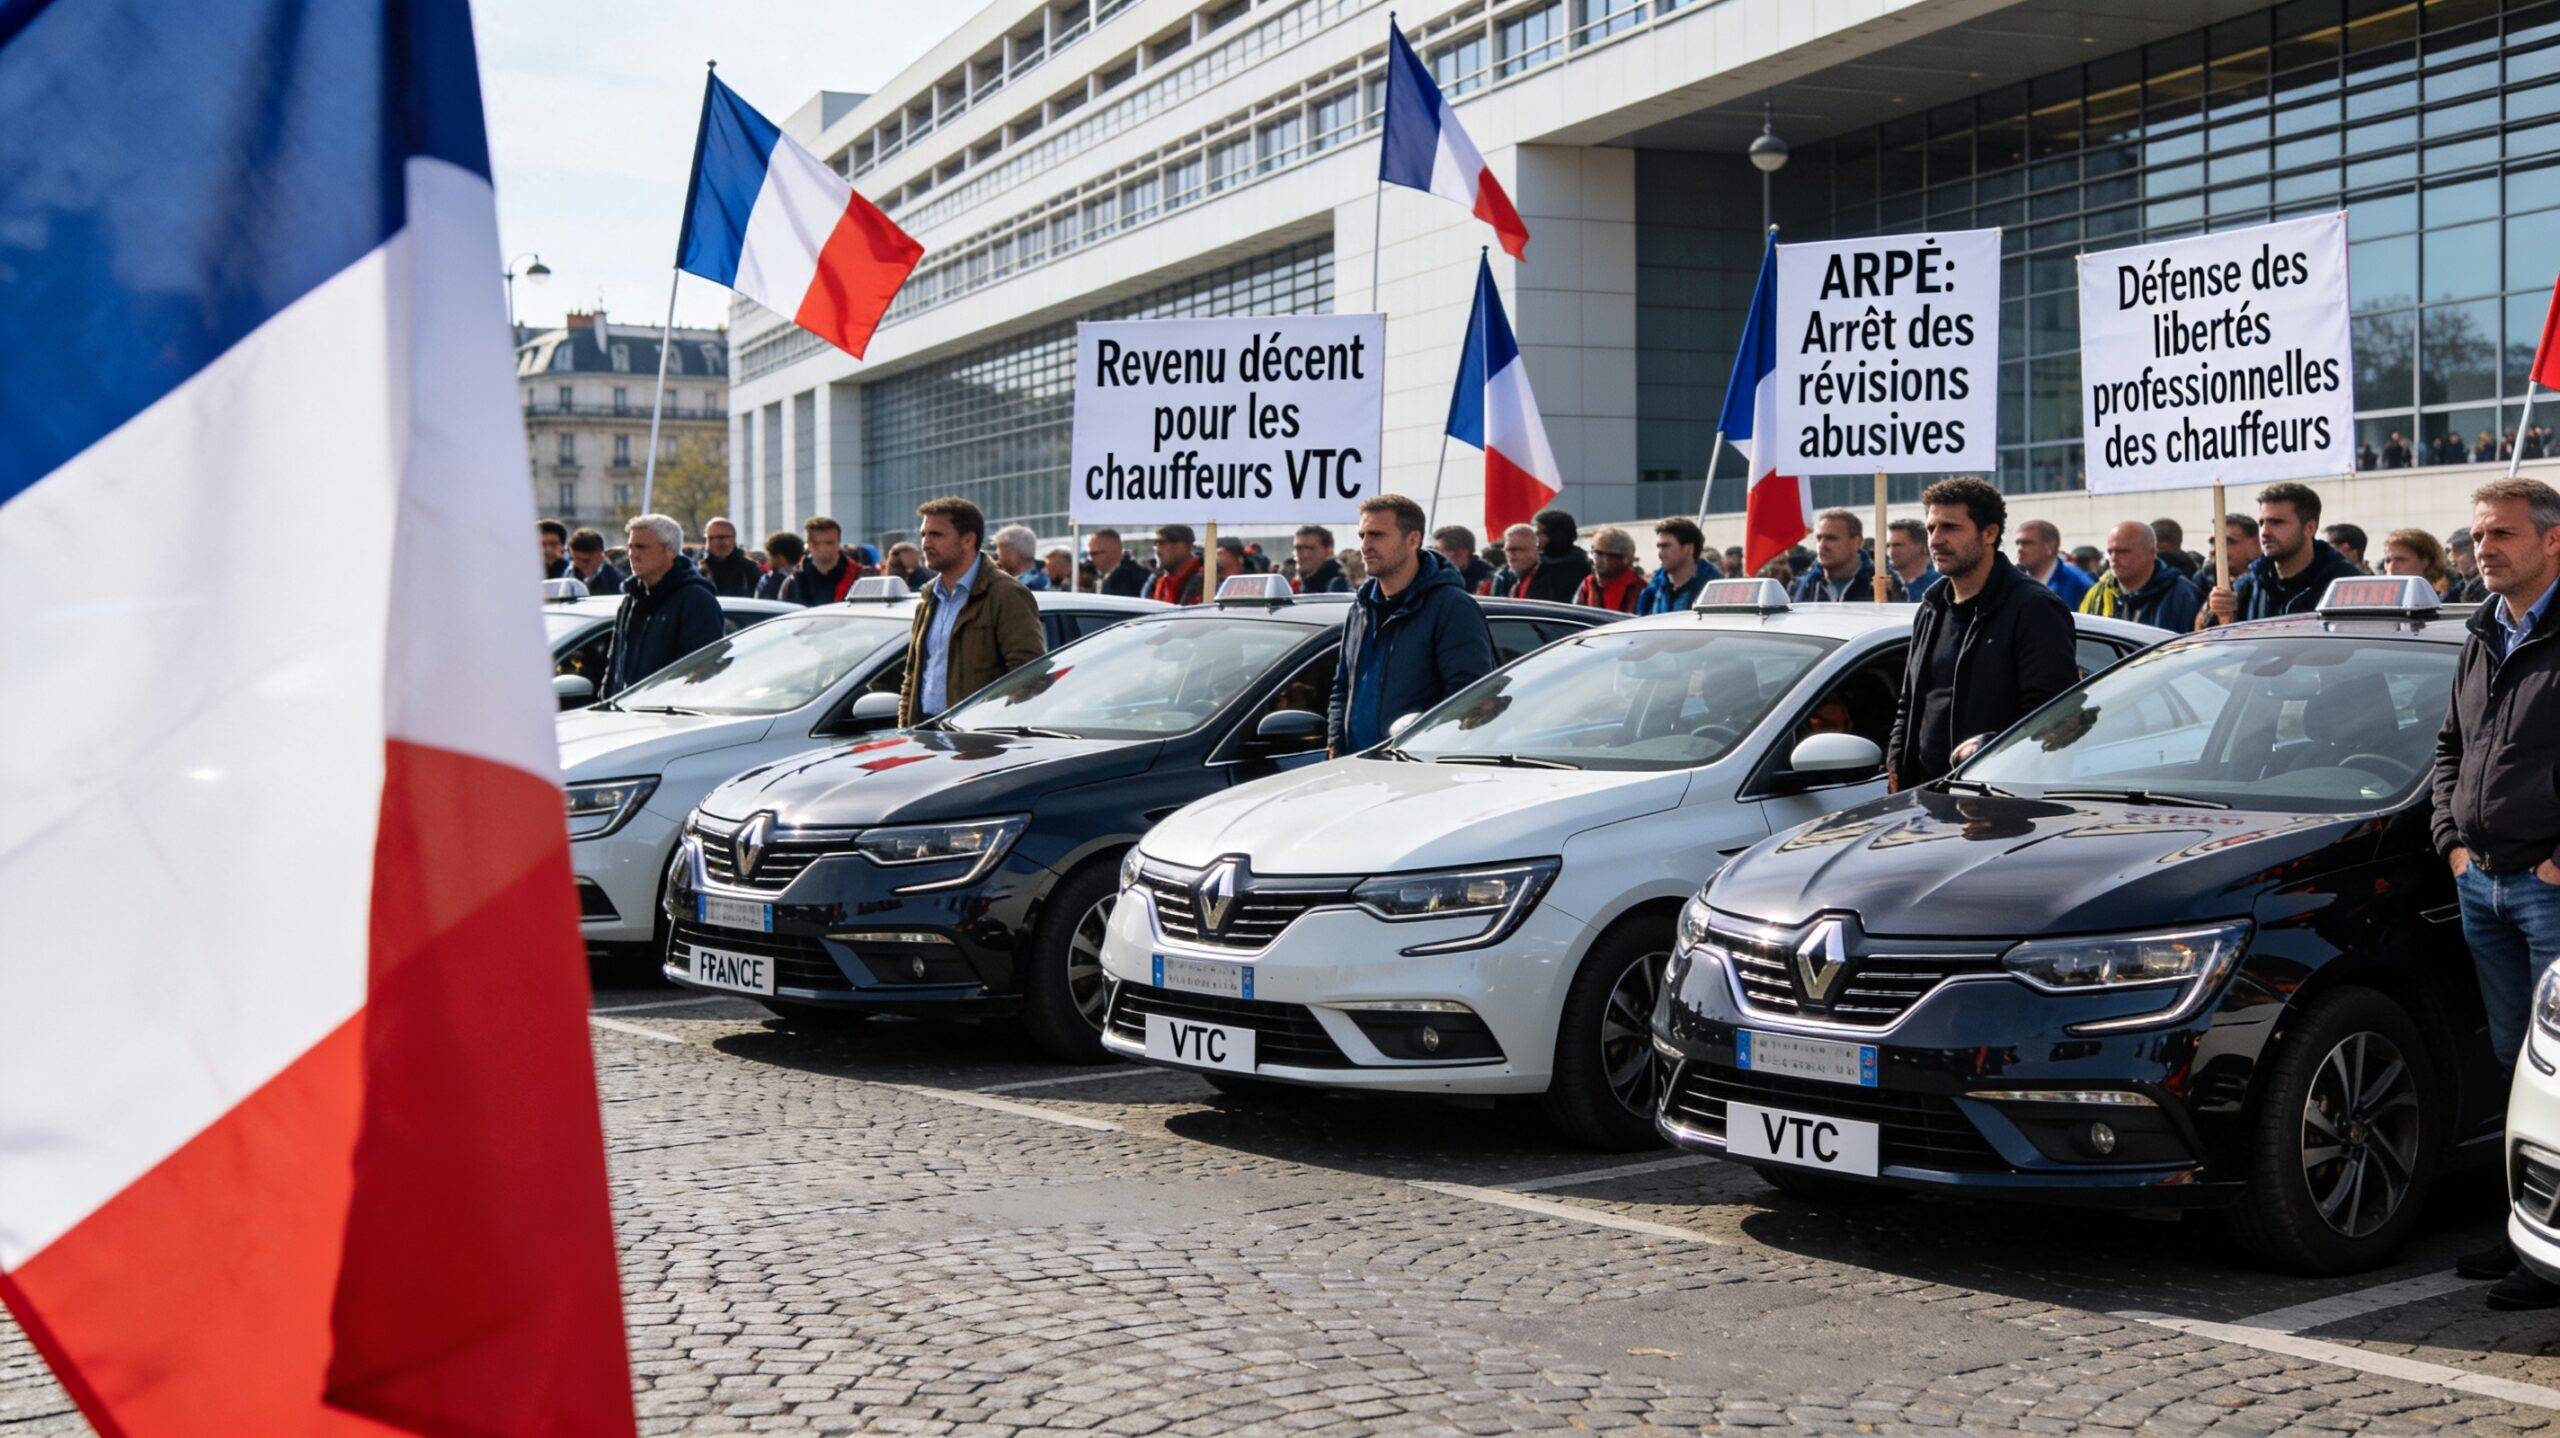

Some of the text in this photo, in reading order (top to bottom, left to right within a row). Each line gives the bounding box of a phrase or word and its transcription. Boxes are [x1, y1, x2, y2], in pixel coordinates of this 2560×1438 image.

[2119, 244, 2307, 310] Défense des
[1801, 304, 1974, 354] Arrêt des
[2154, 301, 2270, 358] libertés
[1098, 332, 1364, 387] Revenu décent
[1800, 359, 1968, 405] révisions
[2094, 349, 2339, 427] professionnelles
[1154, 392, 1299, 452] pour les
[1800, 412, 1964, 457] abusives
[2106, 410, 2330, 468] des chauffeurs
[1086, 448, 1362, 500] chauffeurs VTC
[1170, 1022, 1226, 1062] VTC
[1761, 1113, 1838, 1162] VTC
